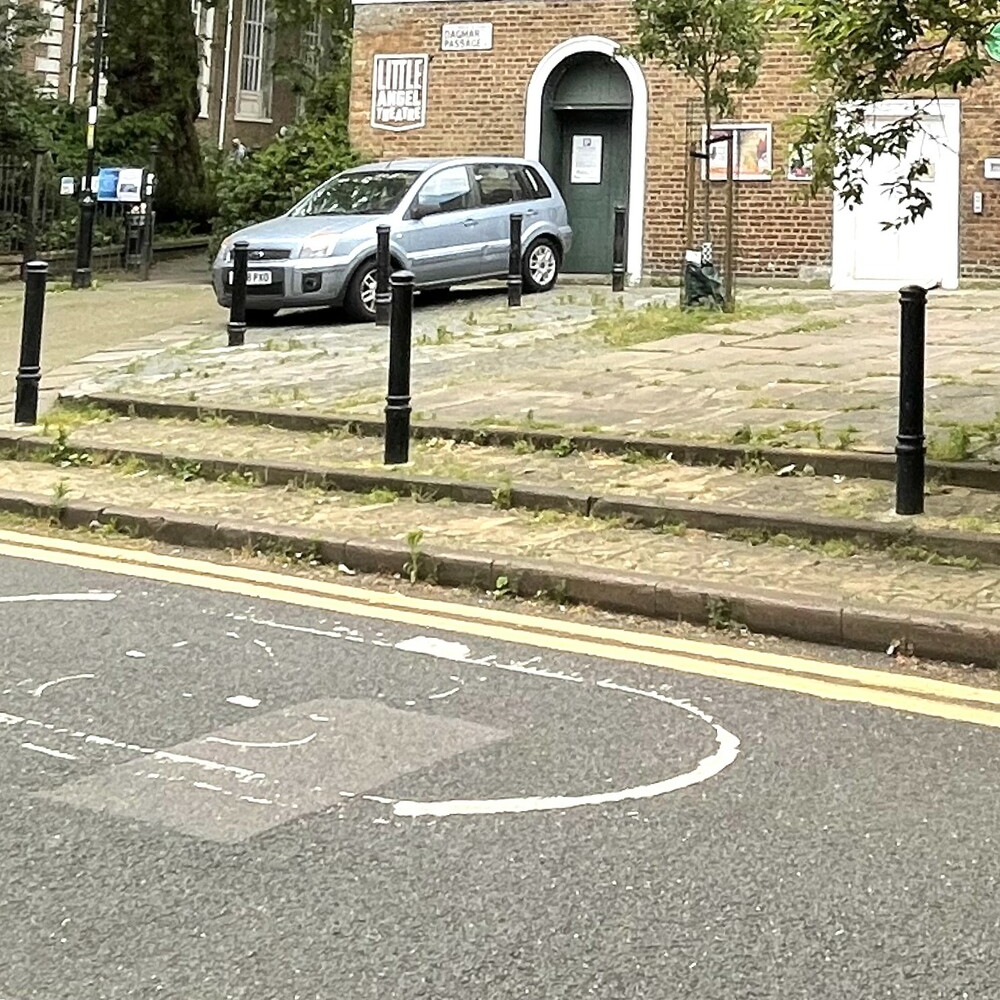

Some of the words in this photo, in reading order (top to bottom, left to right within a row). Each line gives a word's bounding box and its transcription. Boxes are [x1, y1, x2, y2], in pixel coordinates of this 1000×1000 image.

[444, 29, 480, 39] DAGMAR
[444, 38, 481, 48] PASSAGE
[377, 59, 423, 90] LITTLE
[377, 89, 422, 108] ANGEL
[376, 106, 422, 122] THEATRE
